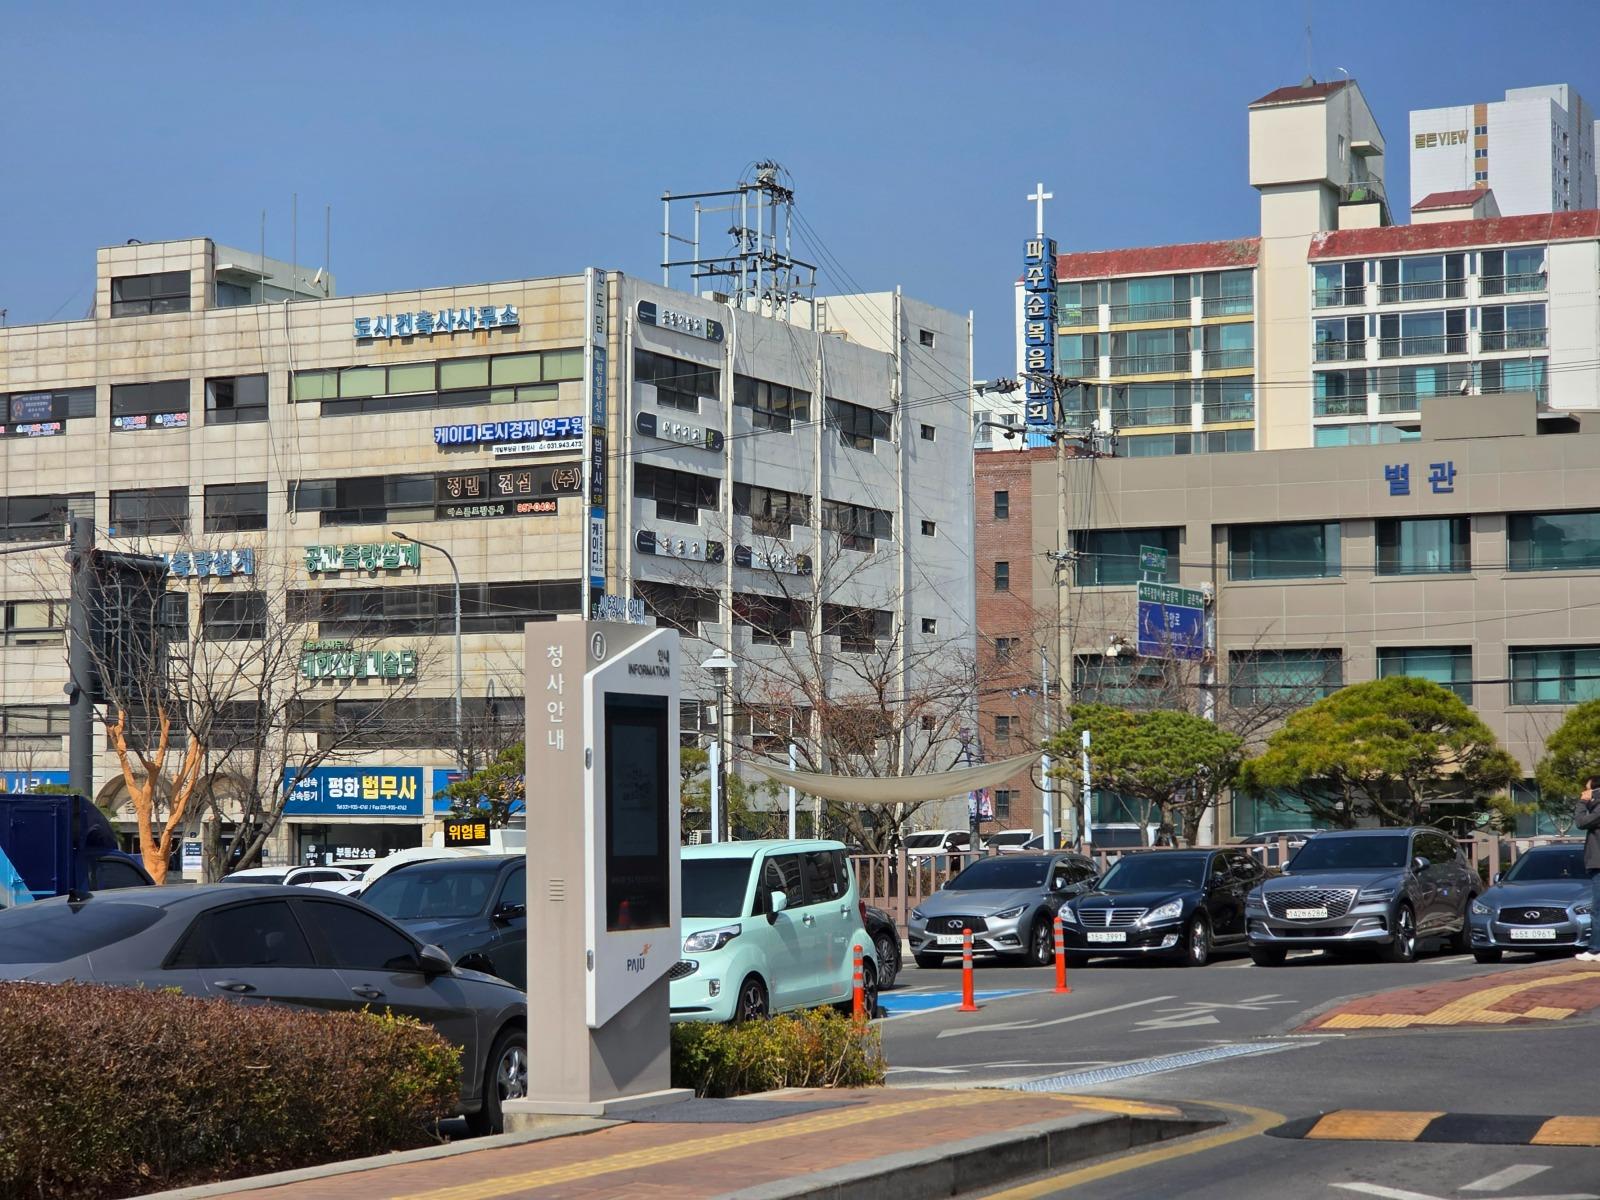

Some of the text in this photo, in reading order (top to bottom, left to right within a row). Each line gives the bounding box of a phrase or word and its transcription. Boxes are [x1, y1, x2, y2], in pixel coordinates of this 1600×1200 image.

[353, 305, 519, 338] 도시건축사사무소
[1026, 241, 1047, 421] 파주순복음교회
[434, 425, 476, 443] 케이디
[542, 416, 583, 436] 연구원
[546, 440, 583, 450] 031.943.473
[447, 468, 581, 497] 정민 건설 (주)
[163, 548, 253, 577] 측량설계
[303, 543, 420, 572] 공간측량설계
[658, 649, 670, 663] 안내
[628, 663, 670, 677] INFORMATION
[547, 645, 564, 750] 청사안내
[328, 775, 417, 800] 평화 법무사
[449, 824, 486, 840] 위험물
[627, 957, 645, 973] PAJU
